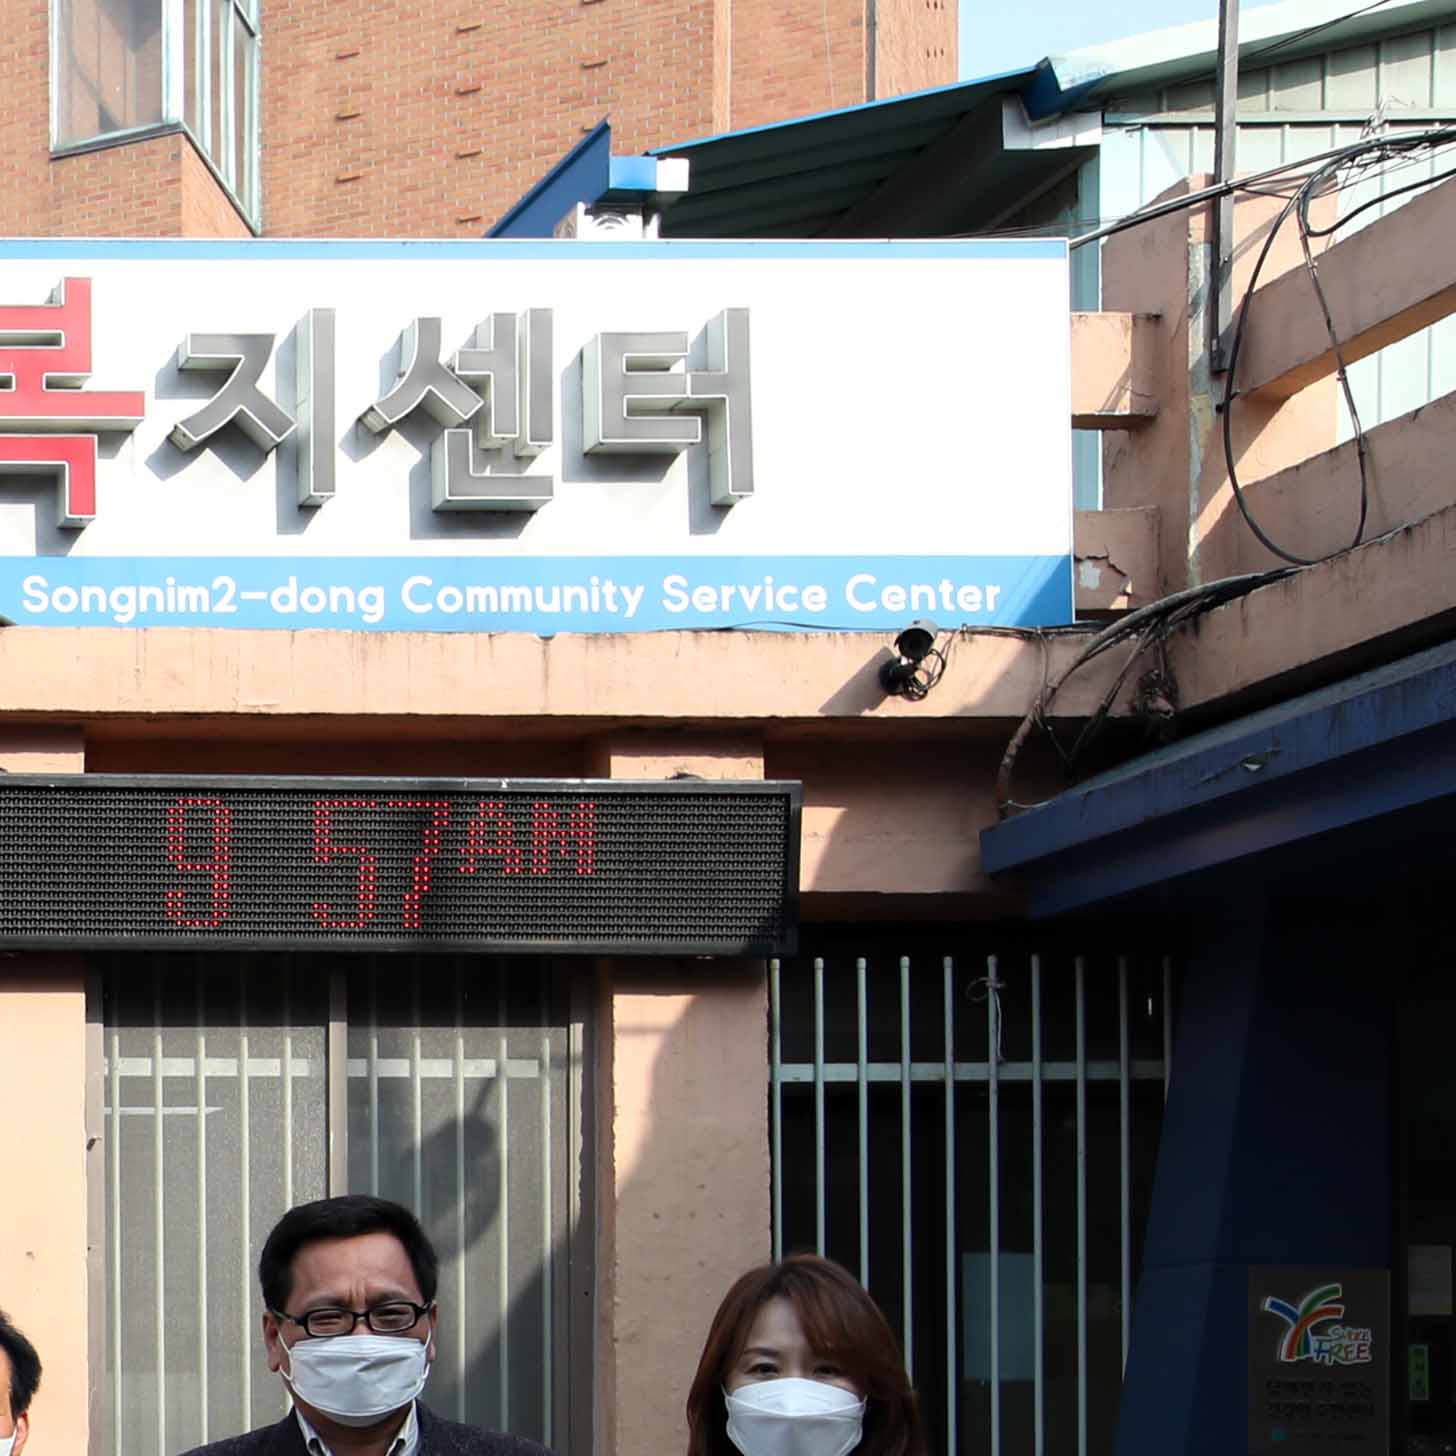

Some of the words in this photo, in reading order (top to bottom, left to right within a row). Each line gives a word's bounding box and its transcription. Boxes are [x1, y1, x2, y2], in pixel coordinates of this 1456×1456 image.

[21, 574, 385, 623] Songnim2-dong
[400, 575, 645, 618] Community
[662, 574, 827, 613] Service
[845, 573, 1002, 613] Center
[164, 797, 232, 930] 9
